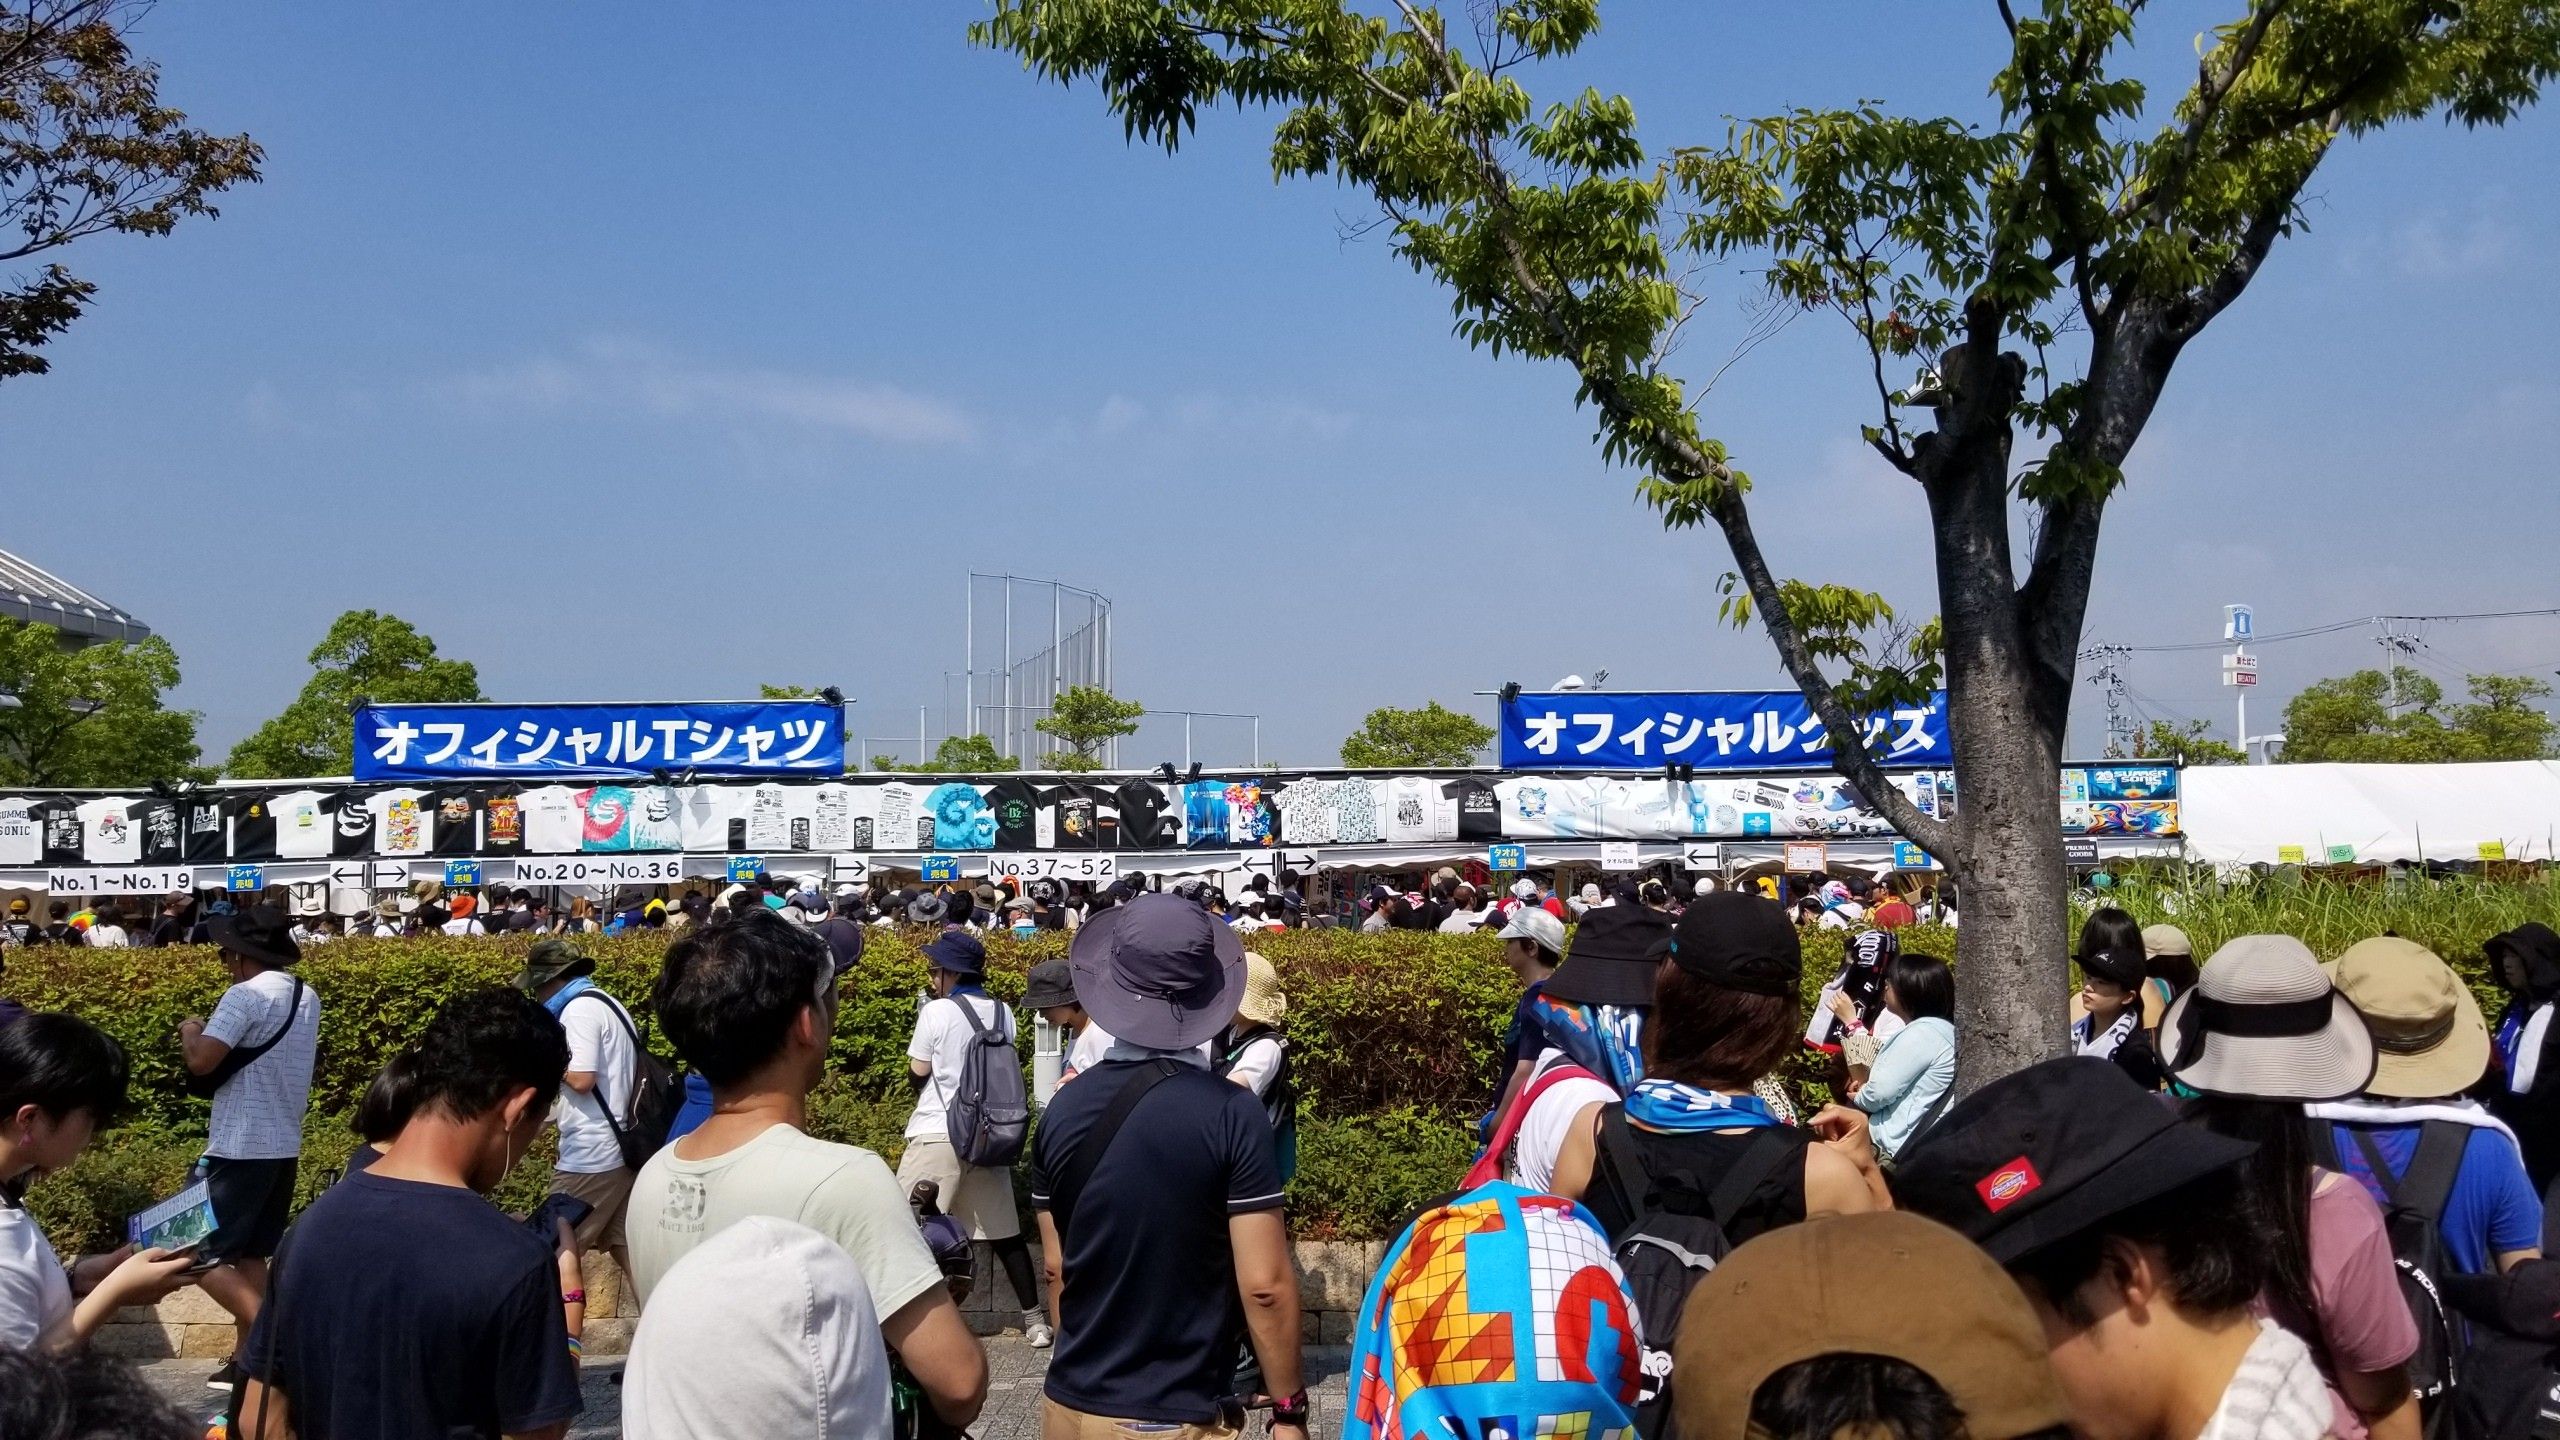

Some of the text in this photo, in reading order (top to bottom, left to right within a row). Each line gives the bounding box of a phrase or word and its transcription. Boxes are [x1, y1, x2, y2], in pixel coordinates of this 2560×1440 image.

[373, 719, 827, 767] オフィシャルTシャツ
[0, 810, 30, 819] UMME
[1494, 848, 1519, 858] タオル
[446, 862, 480, 873] Tシャツ
[729, 858, 763, 869] Tシャツ
[923, 858, 957, 868] Tシャツ
[229, 867, 262, 878] Tシャツ
